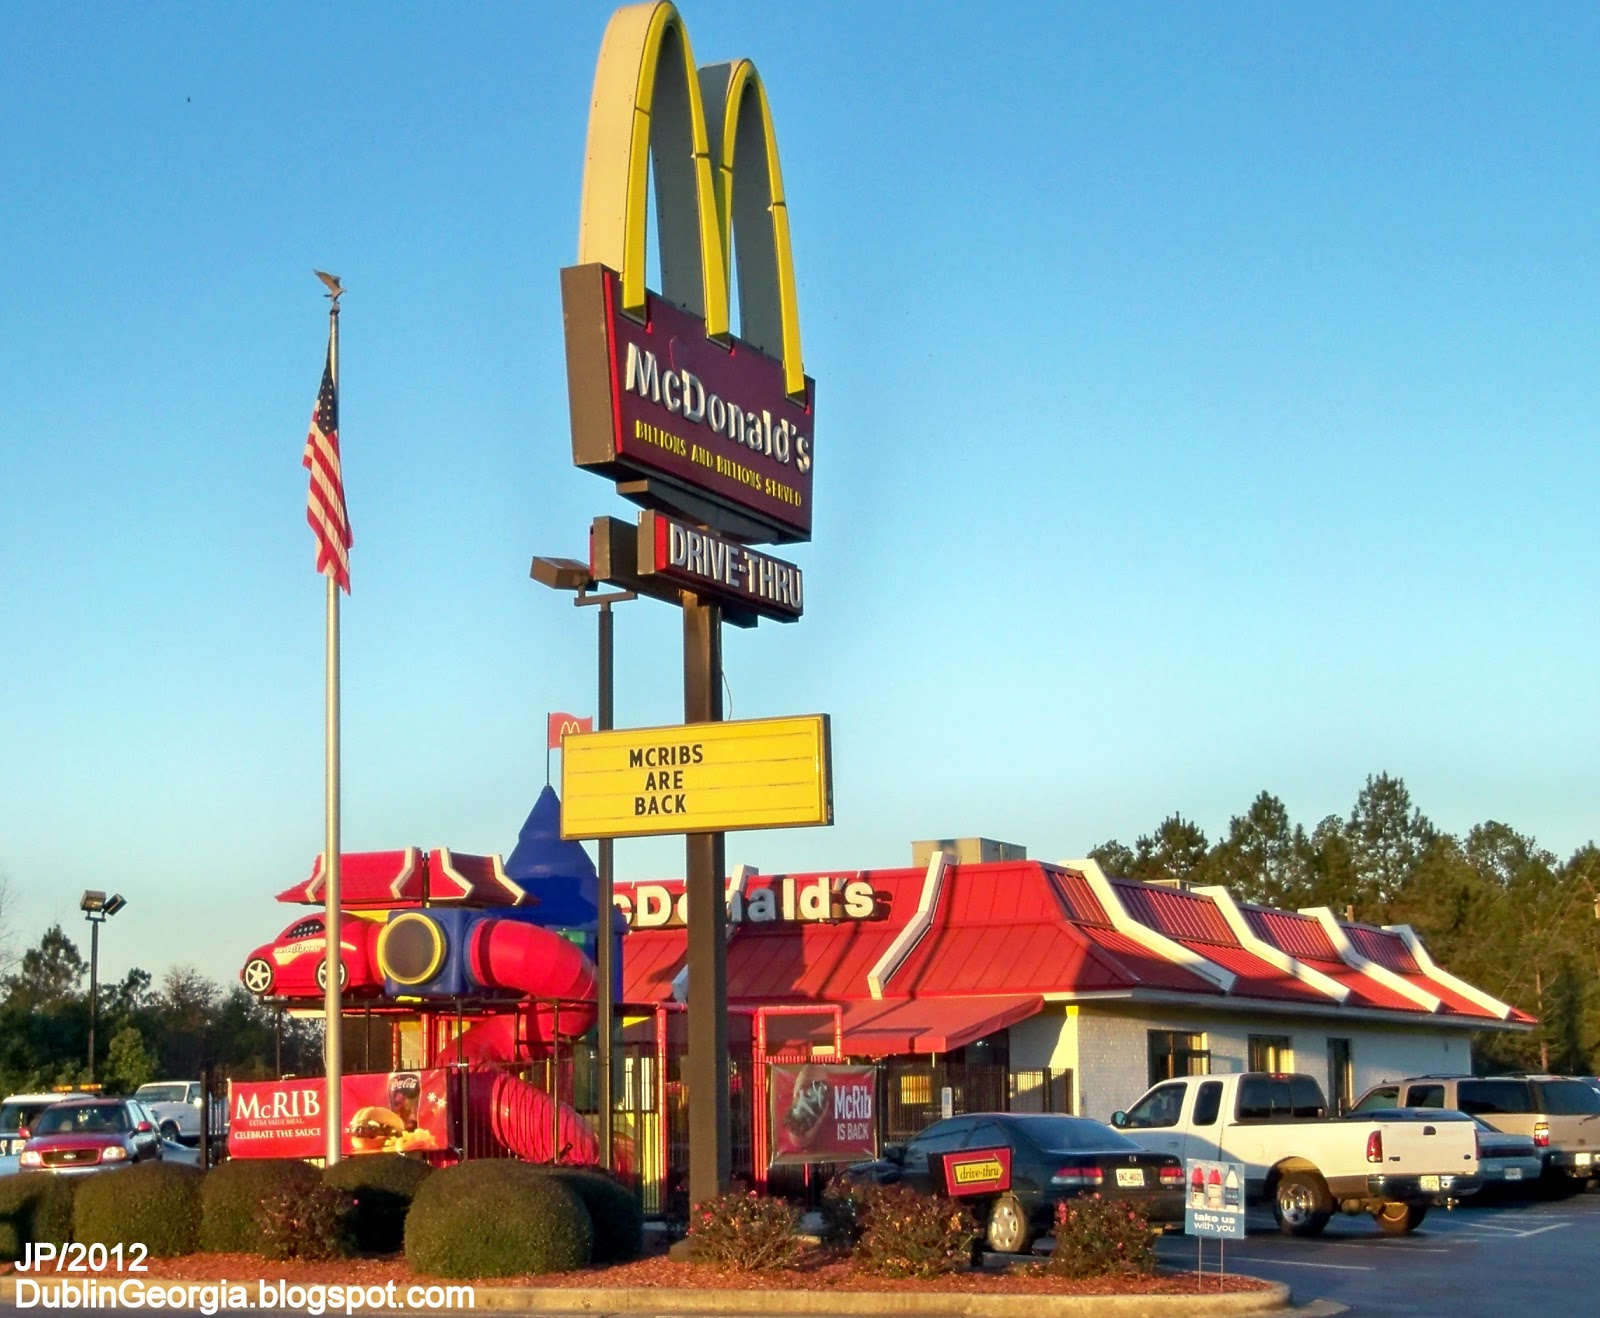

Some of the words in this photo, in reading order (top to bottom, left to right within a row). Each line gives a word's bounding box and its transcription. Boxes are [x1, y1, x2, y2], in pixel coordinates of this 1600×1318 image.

[626, 342, 810, 473] McDonald's
[635, 419, 687, 457] BILLIONS
[691, 444, 714, 468] AND
[716, 455, 762, 490] BILLIONS
[765, 478, 802, 507] SERVED
[669, 522, 802, 608] DRIVE-THRU
[629, 743, 703, 768] MCRIBS
[645, 770, 683, 791] ARE
[634, 794, 687, 816] BACK
[834, 1085, 872, 1119] McRib
[234, 1130, 274, 1140] CELEBRATE
[276, 1129, 293, 1138] THE
[295, 1128, 321, 1137] SAUCE
[837, 1123, 846, 1140] IS
[847, 1122, 869, 1140] BACK
[959, 1162, 999, 1180] drive-thru
[1193, 1222, 1214, 1230] with
[1216, 1224, 1236, 1232] you
[1194, 1212, 1219, 1223] take
[1221, 1216, 1236, 1224] us
